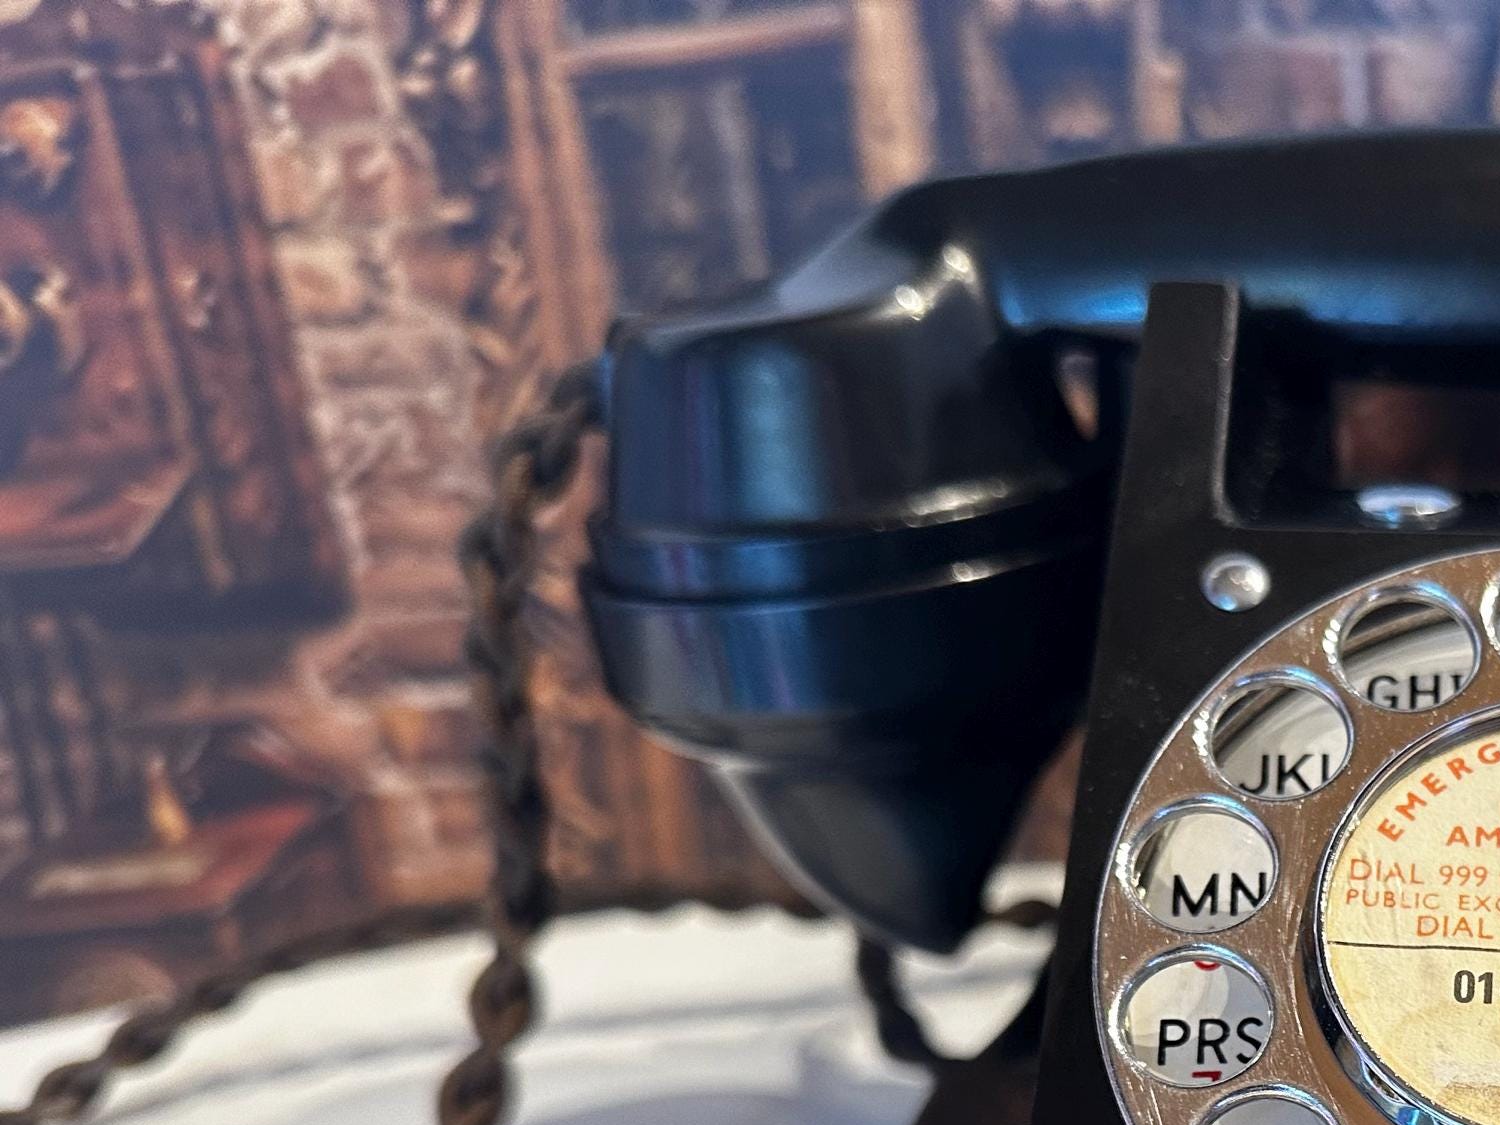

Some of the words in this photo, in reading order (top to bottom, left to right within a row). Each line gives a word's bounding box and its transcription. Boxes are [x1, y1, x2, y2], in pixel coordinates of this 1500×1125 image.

[1349, 858, 1424, 885] DIAL
[1439, 865, 1488, 887] 999
[1172, 872, 1267, 917] MN
[1346, 889, 1440, 910] PUBLIC
[1416, 915, 1493, 940] DIAL
[1157, 1017, 1264, 1066] PRS
